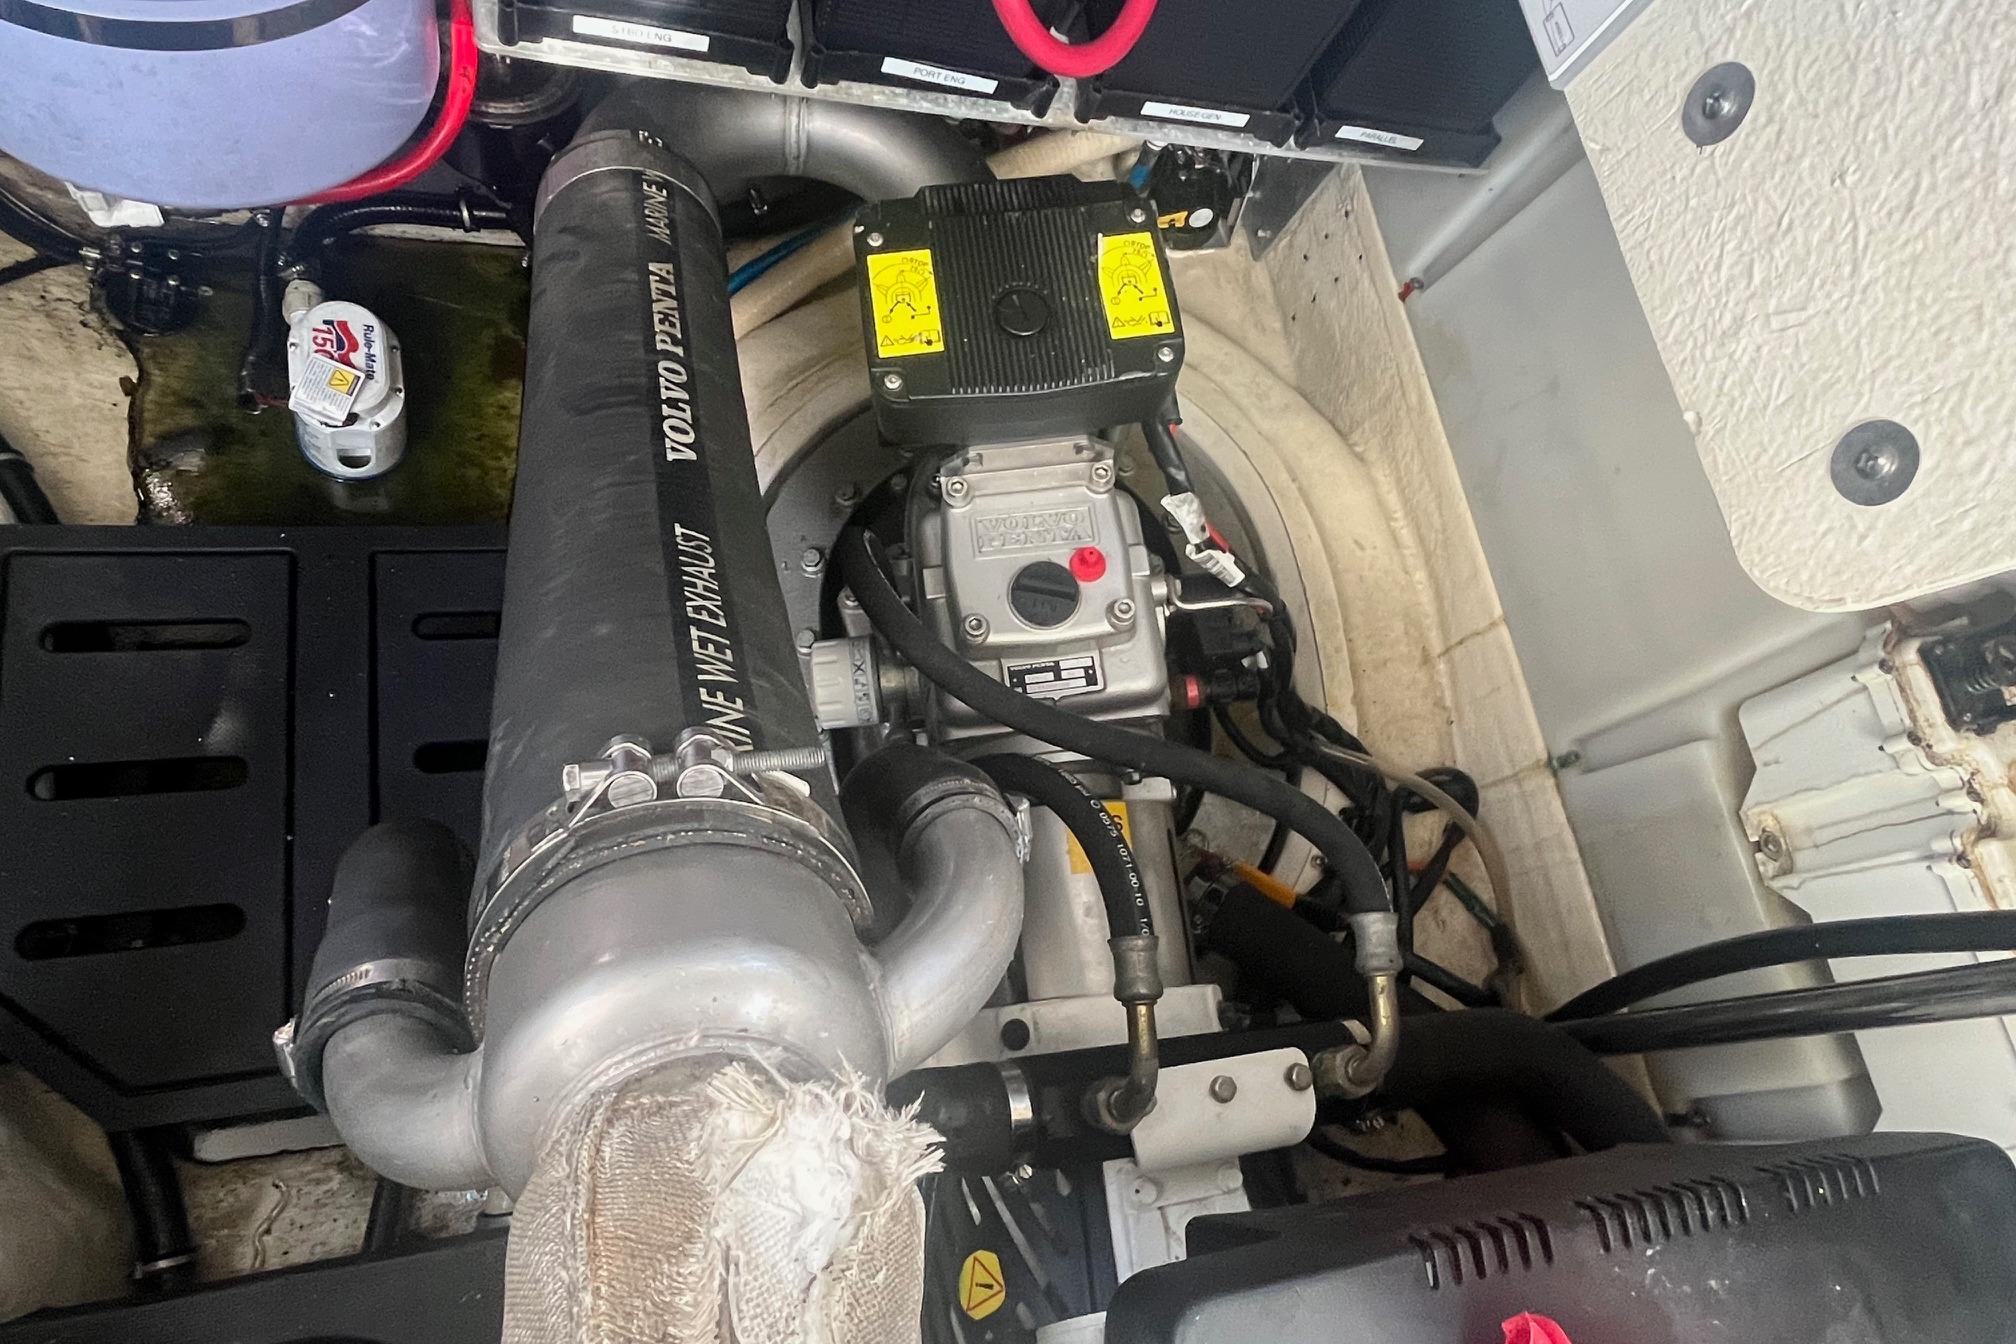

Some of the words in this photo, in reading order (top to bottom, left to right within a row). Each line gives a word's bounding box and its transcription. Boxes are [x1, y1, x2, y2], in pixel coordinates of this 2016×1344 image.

[913, 66, 942, 79] PORT
[943, 73, 966, 85] ENG
[643, 182, 672, 245] MARINE
[648, 262, 684, 357] PENTA
[363, 324, 378, 380] Rule-Mate
[658, 360, 697, 462] VOLVO
[674, 523, 727, 627] EXHAUST
[690, 625, 739, 683] WET
[700, 687, 753, 751] INE
